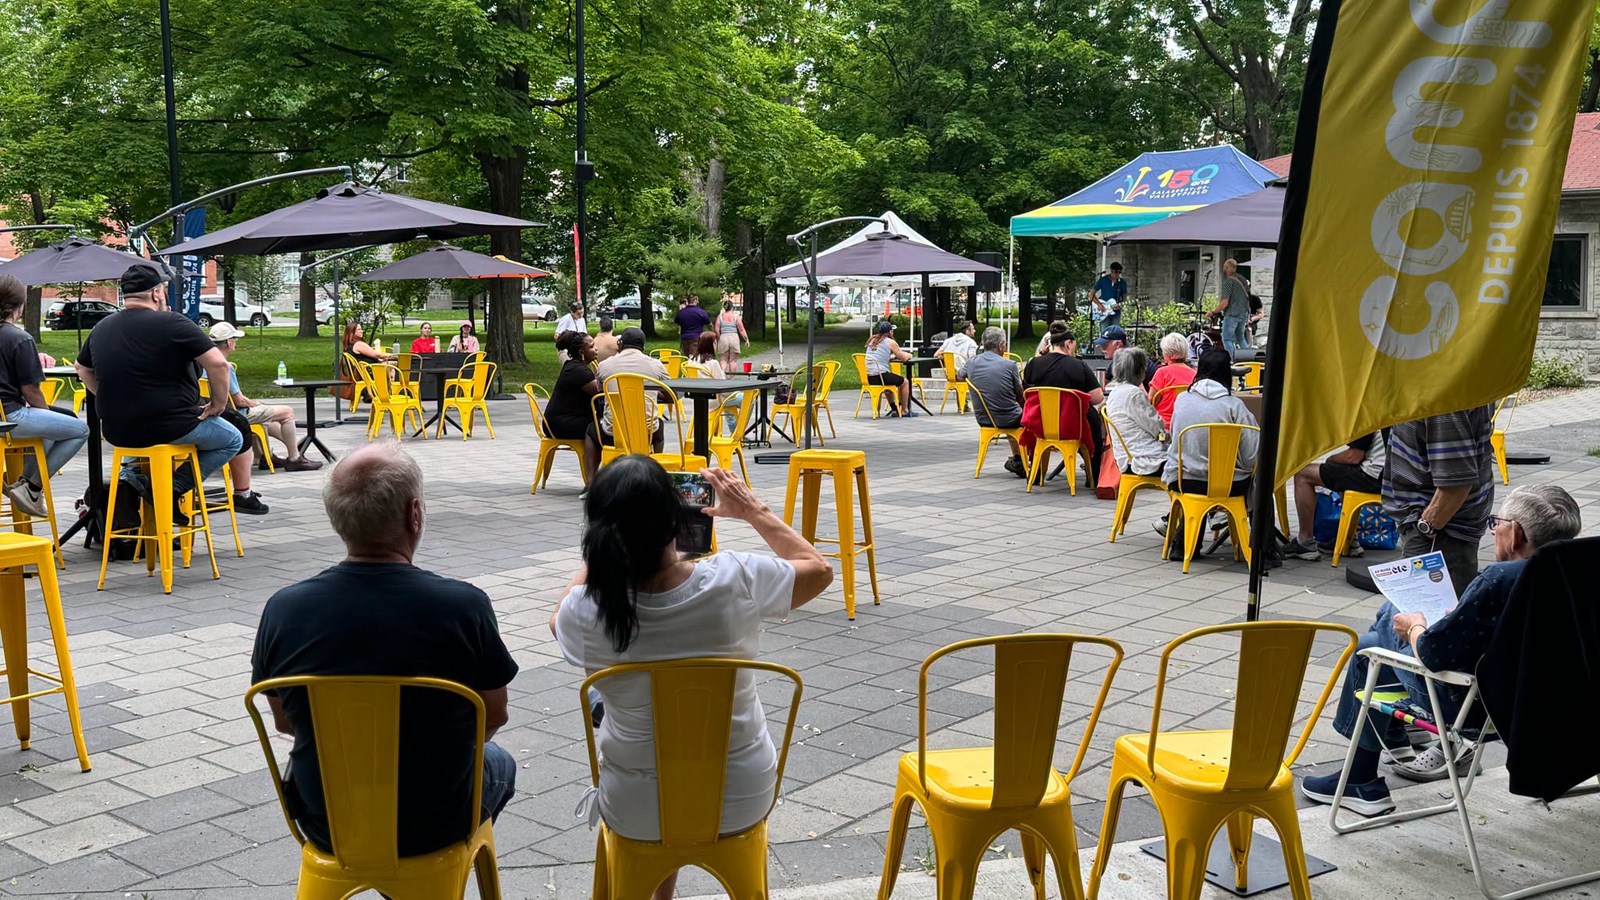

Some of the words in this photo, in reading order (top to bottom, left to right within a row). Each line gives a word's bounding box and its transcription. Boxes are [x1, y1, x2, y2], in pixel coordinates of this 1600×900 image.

[1502, 65, 1547, 149] 1874
[1157, 164, 1220, 189] 150
[1477, 167, 1529, 305] DEPUIS
